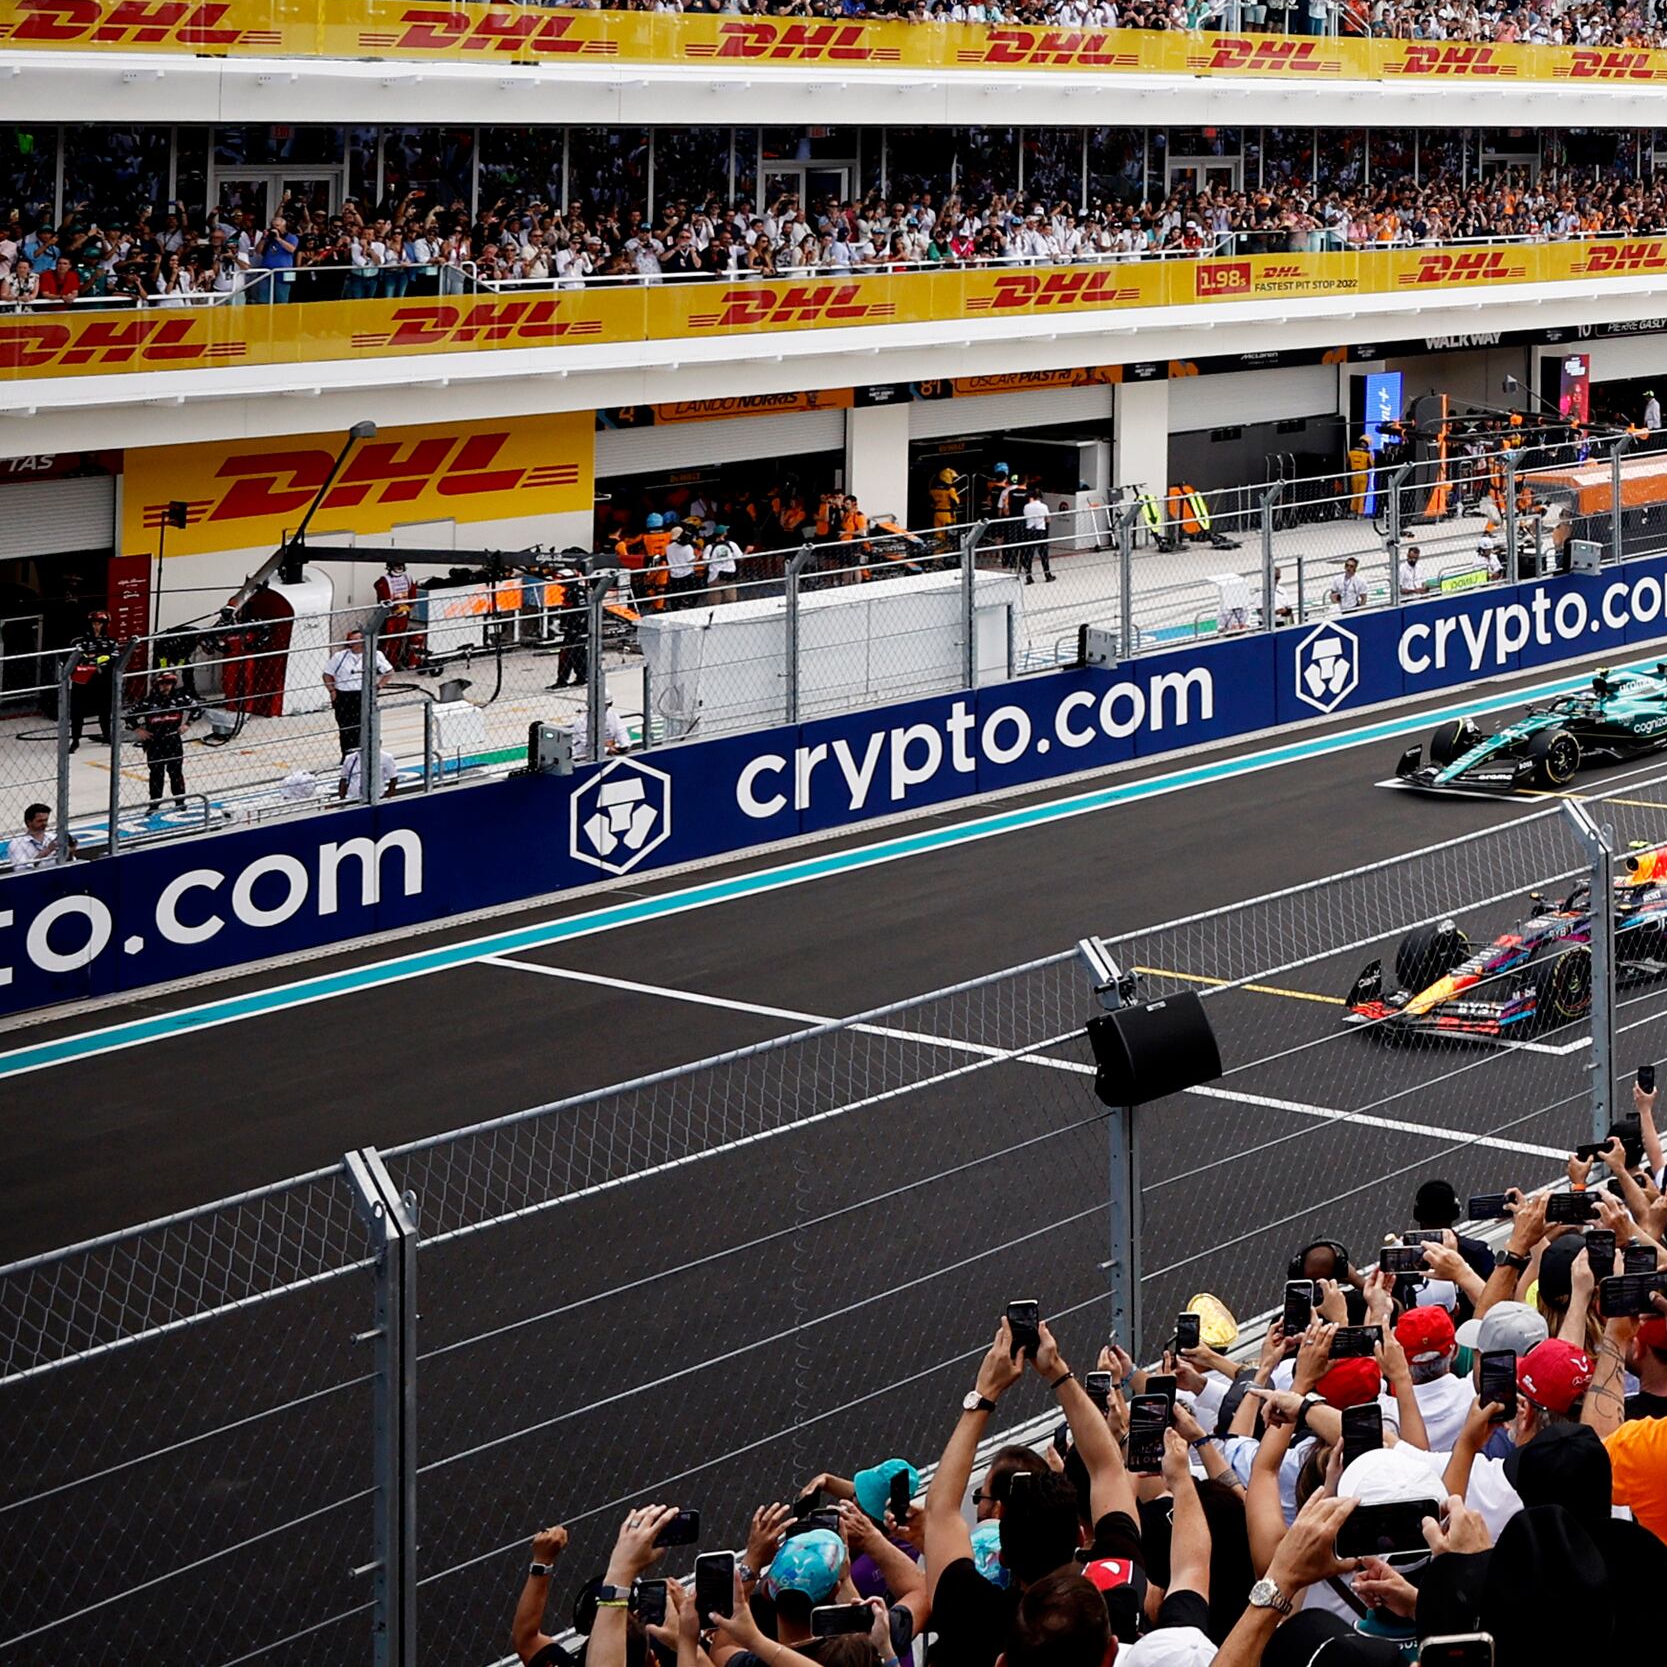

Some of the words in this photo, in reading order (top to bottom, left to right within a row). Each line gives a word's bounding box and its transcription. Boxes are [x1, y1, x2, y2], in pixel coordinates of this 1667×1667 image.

[400, 10, 585, 53] DHL
[719, 23, 873, 61] DHL
[986, 31, 1114, 65] DHL
[1210, 39, 1321, 71] DHL
[1402, 45, 1500, 75] DHL
[1570, 51, 1653, 78] DHL
[1263, 266, 1301, 278] DHL
[1417, 252, 1509, 282] DHL
[1586, 243, 1665, 272] DHL
[992, 270, 1117, 308] DHL
[1255, 281, 1294, 292] FASTEST
[1296, 280, 1311, 290] PIT
[1313, 279, 1335, 289] STOP
[1336, 279, 1358, 289] 2022
[719, 284, 868, 326] DHL
[390, 300, 570, 346] DHL
[1638, 318, 1667, 330] GASLY
[0, 318, 206, 368] DHL
[969, 372, 1018, 389] OSCAR
[619, 407, 635, 423] 4
[675, 396, 735, 415] LANDO
[736, 391, 798, 409] NORRIS
[208, 432, 528, 521] DHL
[735, 666, 1214, 819] crypto.com
